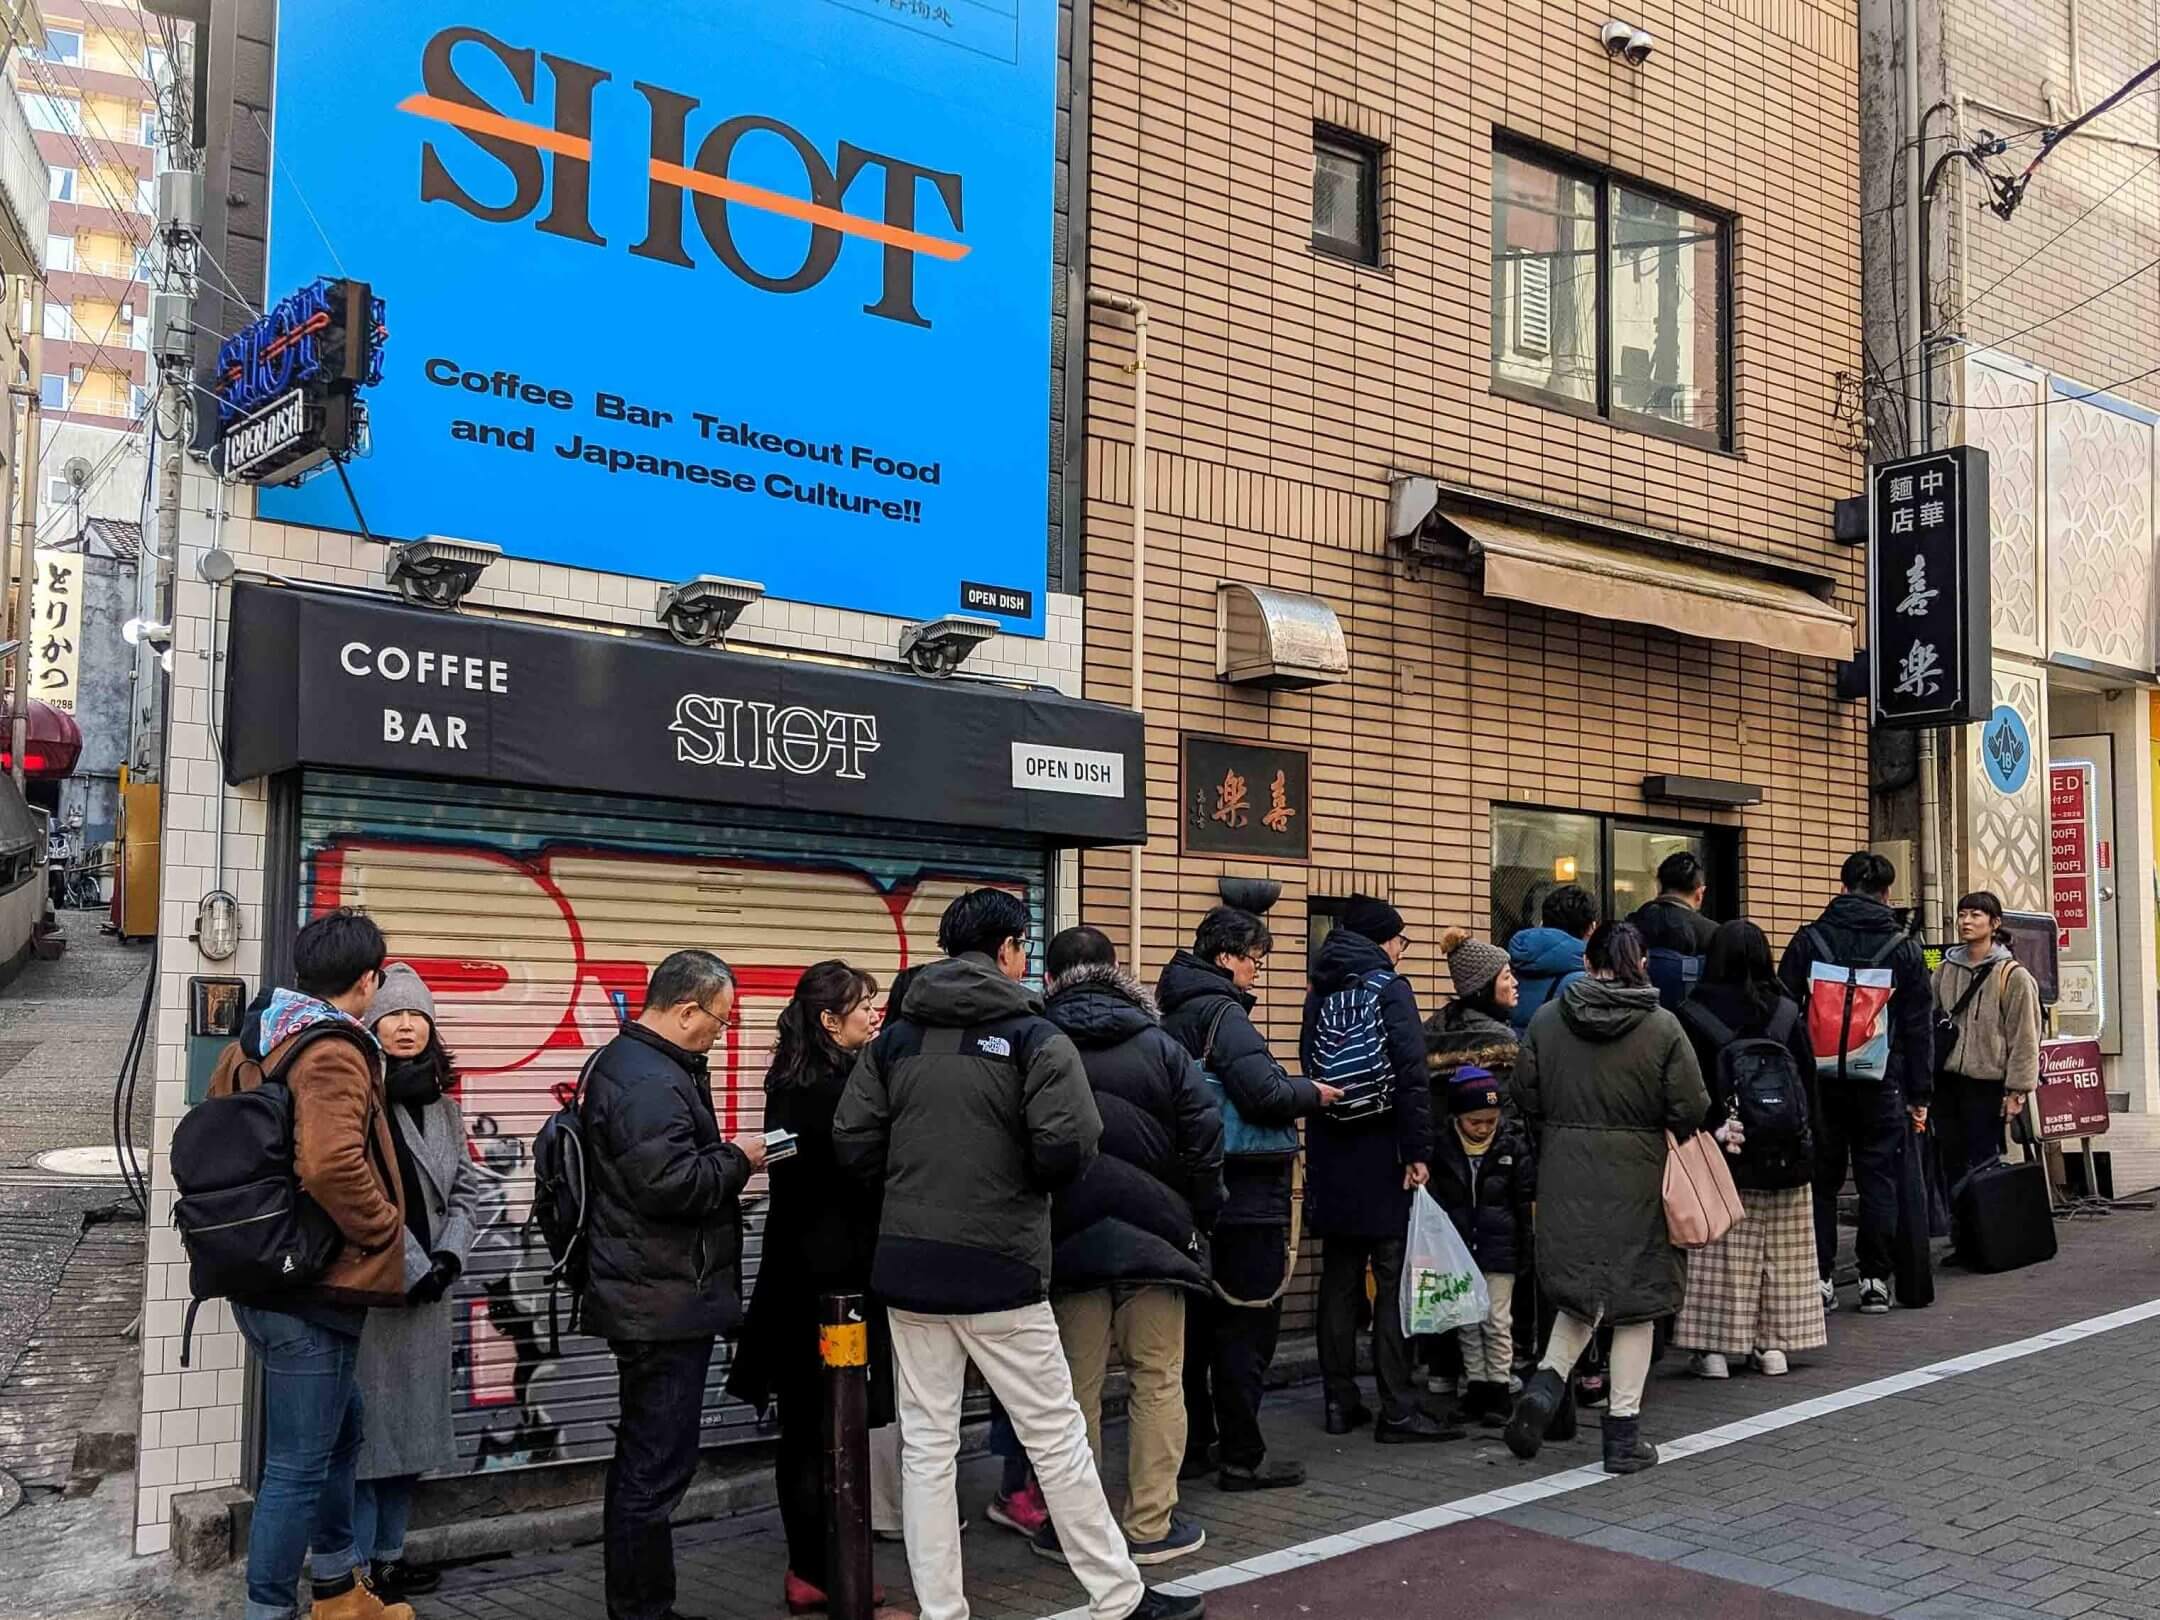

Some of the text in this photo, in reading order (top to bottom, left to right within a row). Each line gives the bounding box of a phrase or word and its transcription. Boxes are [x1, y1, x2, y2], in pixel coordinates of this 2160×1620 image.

[420, 26, 965, 328] SHOT
[425, 358, 941, 484] Coffee Bar Takeout Food
[451, 418, 922, 523] and Japanese Culture!!
[1920, 470, 1944, 528] 中華
[40, 562, 73, 689] とりかつ
[968, 589, 1025, 611] OPEN DISH
[340, 642, 509, 694] COFFEE
[383, 709, 469, 750] BAR
[669, 694, 880, 779] SHOT
[1026, 757, 1112, 784] OPEN DISH
[2002, 752, 2012, 768] 18
[2039, 1047, 2085, 1072] Vacation
[2073, 1072, 2099, 1089] RED
